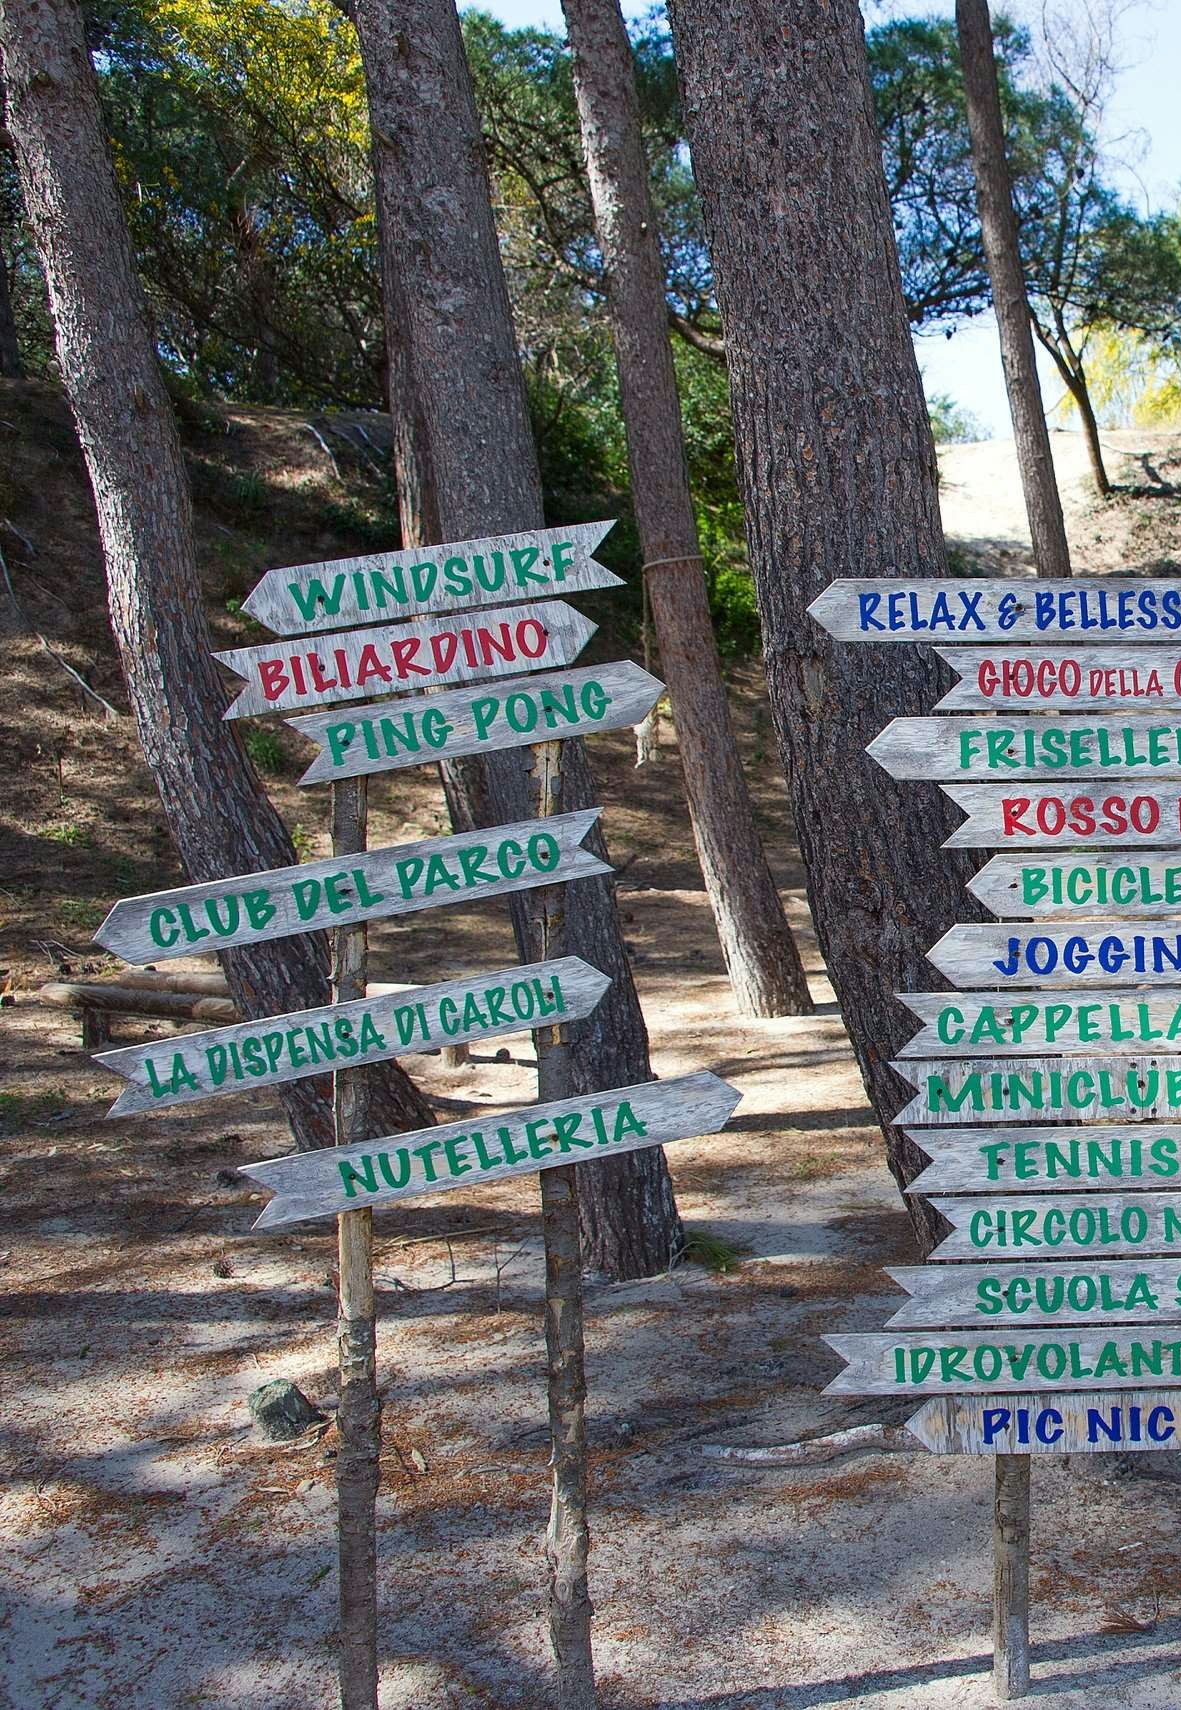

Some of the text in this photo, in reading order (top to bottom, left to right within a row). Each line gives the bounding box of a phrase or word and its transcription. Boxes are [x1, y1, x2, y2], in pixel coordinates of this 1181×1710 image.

[286, 539, 574, 622] WINDSURF
[857, 591, 986, 633] RELAX
[996, 592, 1019, 631] &
[259, 619, 547, 701] BILIARDINO
[978, 659, 1082, 698] GIOCO
[1089, 669, 1163, 697] DELLA
[325, 679, 613, 768] PING PONG
[1002, 795, 1161, 837] ROSSO
[148, 831, 561, 949] CLUB DEL PARCO
[143, 975, 567, 1100] LA DISPENSA DI CAROLI
[336, 1100, 647, 1200] NUTELLERIA
[978, 1136, 1181, 1182] TENNIS
[968, 1205, 1149, 1249] CIRCOLO
[975, 1272, 1160, 1317] SCUOLA
[980, 1406, 1174, 1447] PIC NIC
